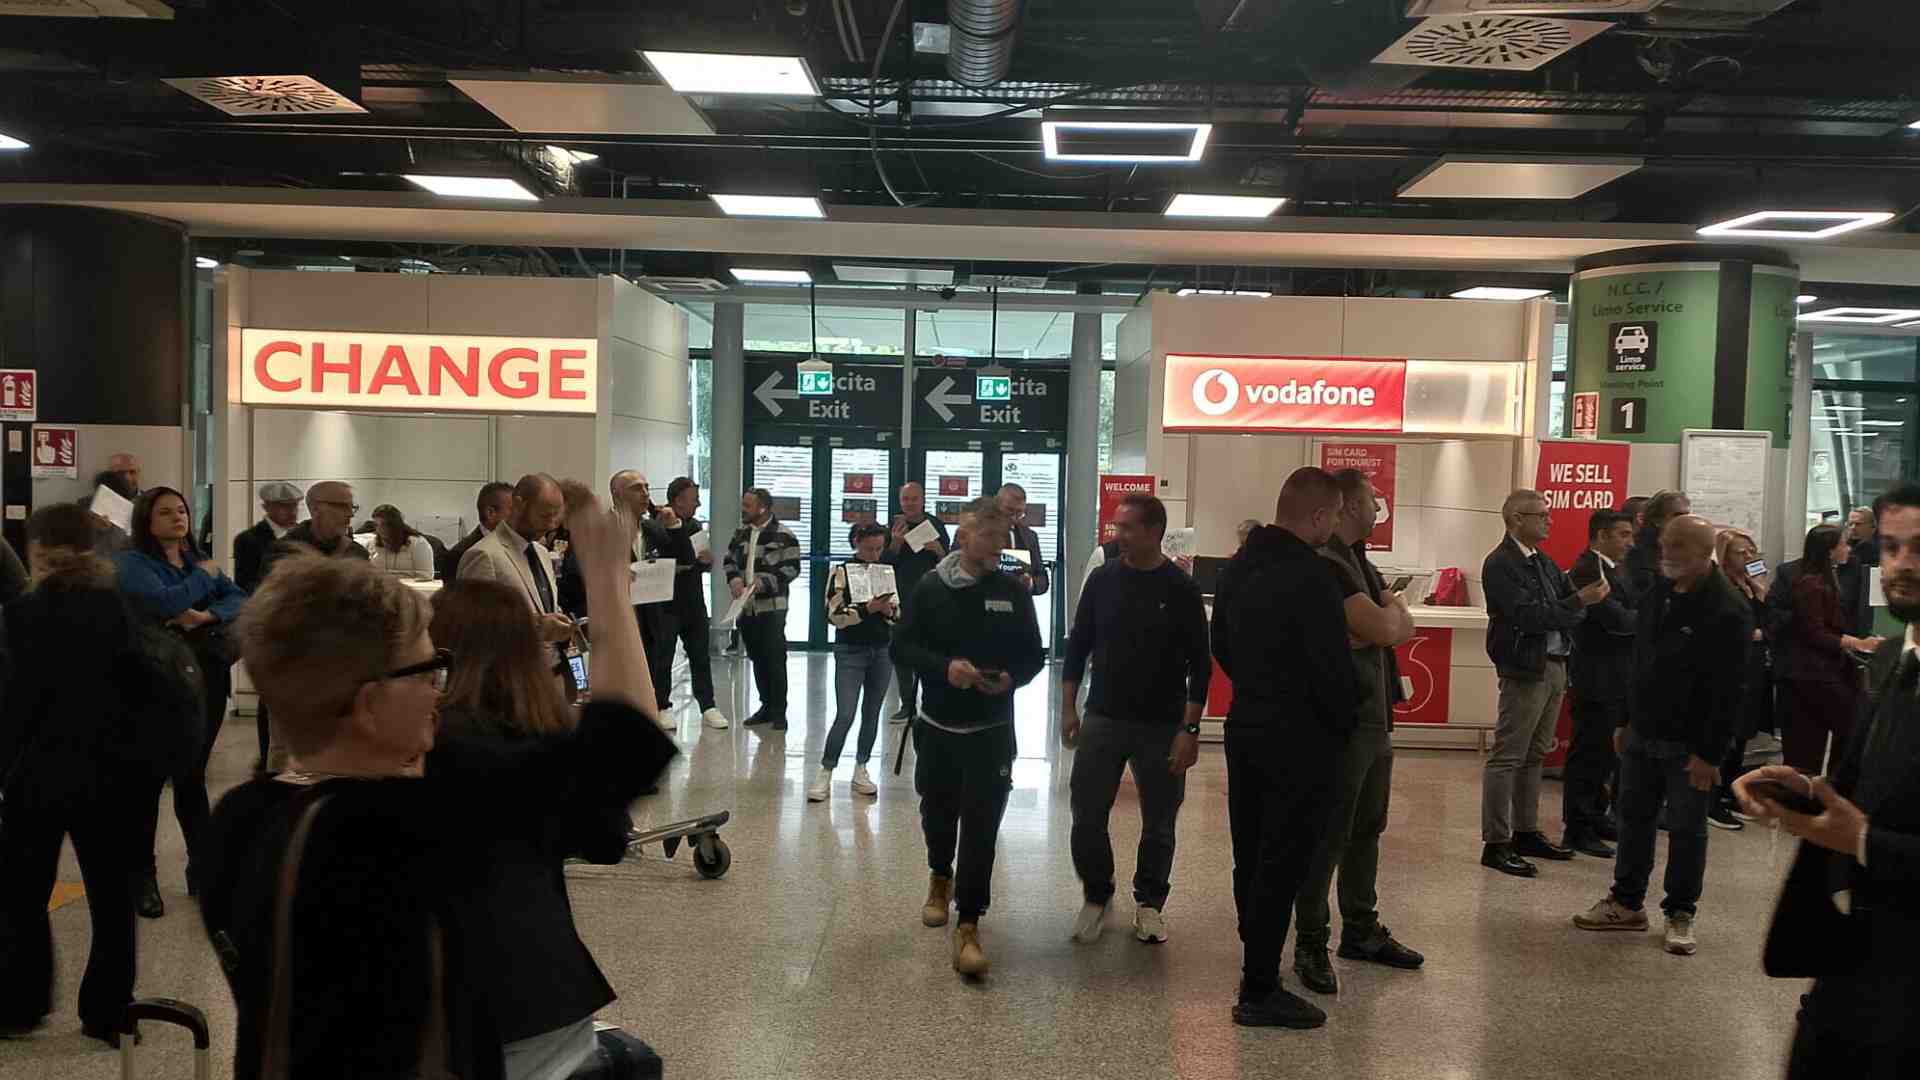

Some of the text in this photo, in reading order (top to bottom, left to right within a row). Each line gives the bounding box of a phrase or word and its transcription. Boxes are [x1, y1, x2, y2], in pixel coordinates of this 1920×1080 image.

[1626, 302, 1684, 315] Service
[254, 341, 587, 400] CHANGE
[1615, 355, 1646, 371] Limo service
[832, 371, 876, 391] cita
[1011, 377, 1048, 395] cita
[1244, 378, 1376, 406] vodafone
[809, 400, 850, 419] Exit
[980, 405, 1021, 424] Exit
[1620, 402, 1634, 429] 1
[1327, 448, 1368, 457] SIM CARD
[1326, 458, 1381, 467] FOR TOURIST
[1550, 463, 1612, 483] WE SELL
[1105, 482, 1152, 492] WELCOME
[1543, 489, 1614, 509] SIM CARD
